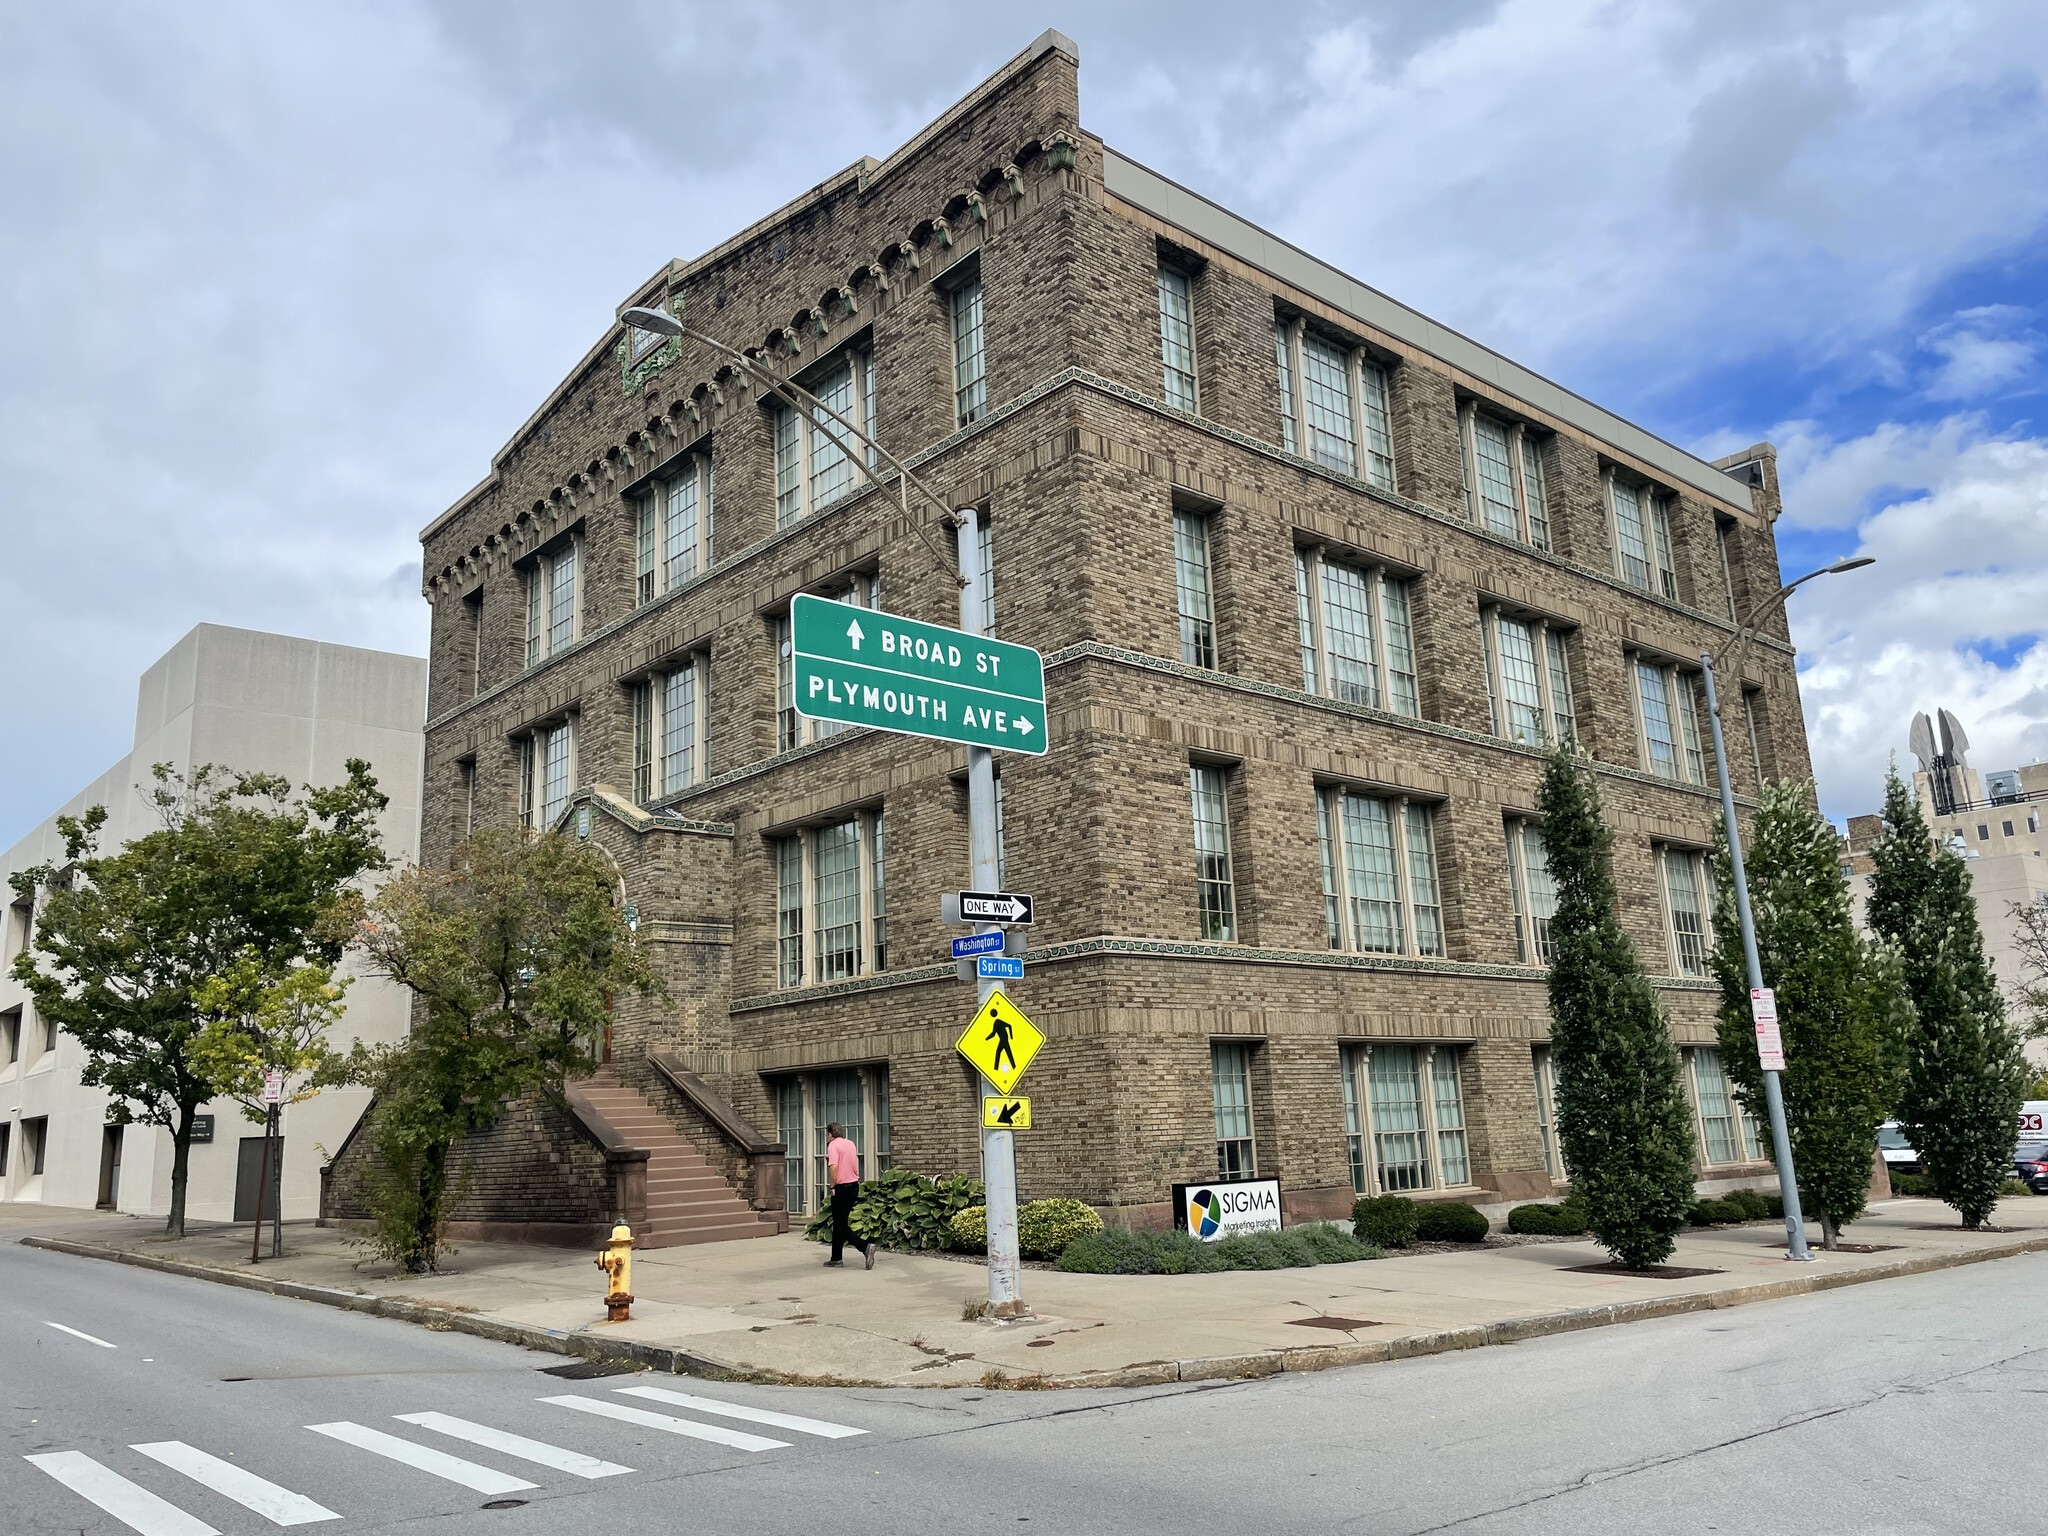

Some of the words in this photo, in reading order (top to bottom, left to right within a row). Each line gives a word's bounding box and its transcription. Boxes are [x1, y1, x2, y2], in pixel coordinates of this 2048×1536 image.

[881, 629, 962, 667] BROAD
[975, 652, 1001, 677] ST
[808, 675, 947, 722] PLYMOUTH
[962, 705, 1008, 733] AVE
[966, 900, 989, 913] ONE
[993, 902, 1015, 914] WAY
[959, 937, 995, 951] Washington
[982, 960, 1013, 975] Spring
[1223, 1190, 1276, 1214] SIGMA
[1225, 1221, 1255, 1231] Marketing
[1256, 1218, 1278, 1228] Insights
